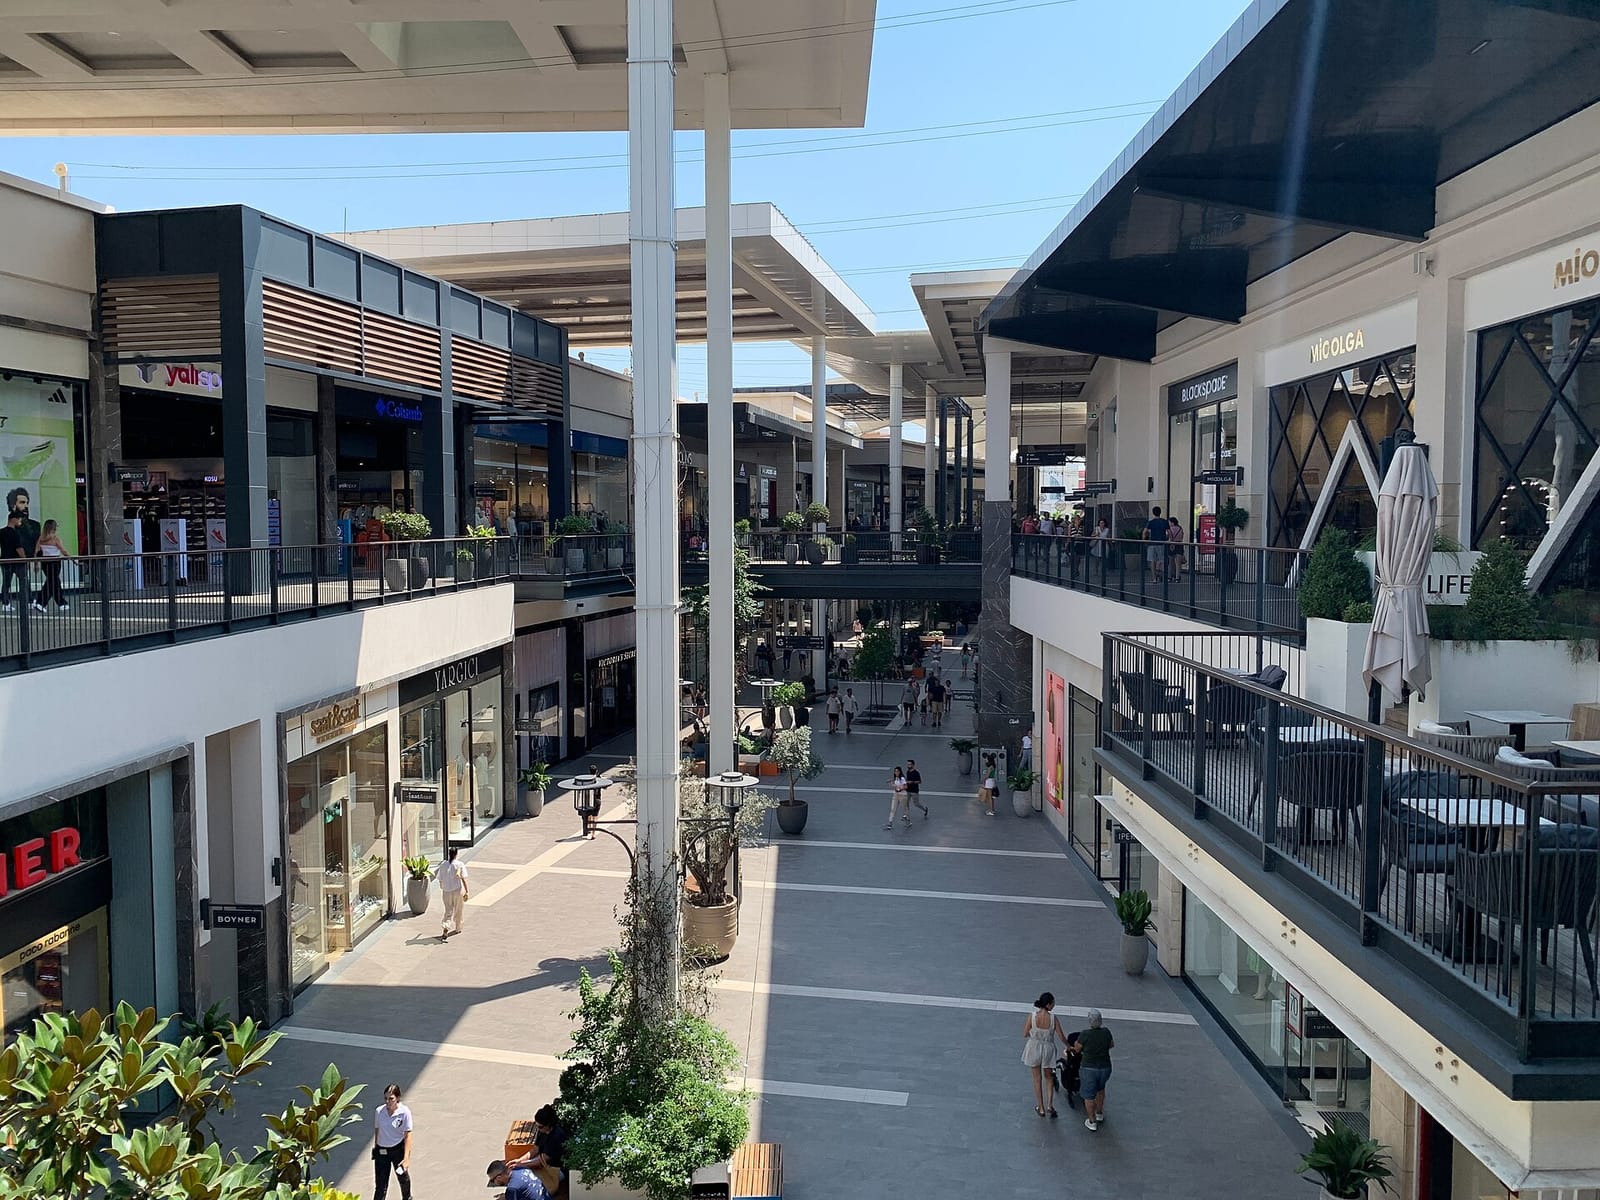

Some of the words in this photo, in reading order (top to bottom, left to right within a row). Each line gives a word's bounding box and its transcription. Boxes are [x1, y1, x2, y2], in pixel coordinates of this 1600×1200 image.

[1427, 575, 1472, 594] LIFE
[217, 916, 257, 924] BOYNER
[19, 943, 43, 962] paco
[44, 923, 81, 948] rabanne
